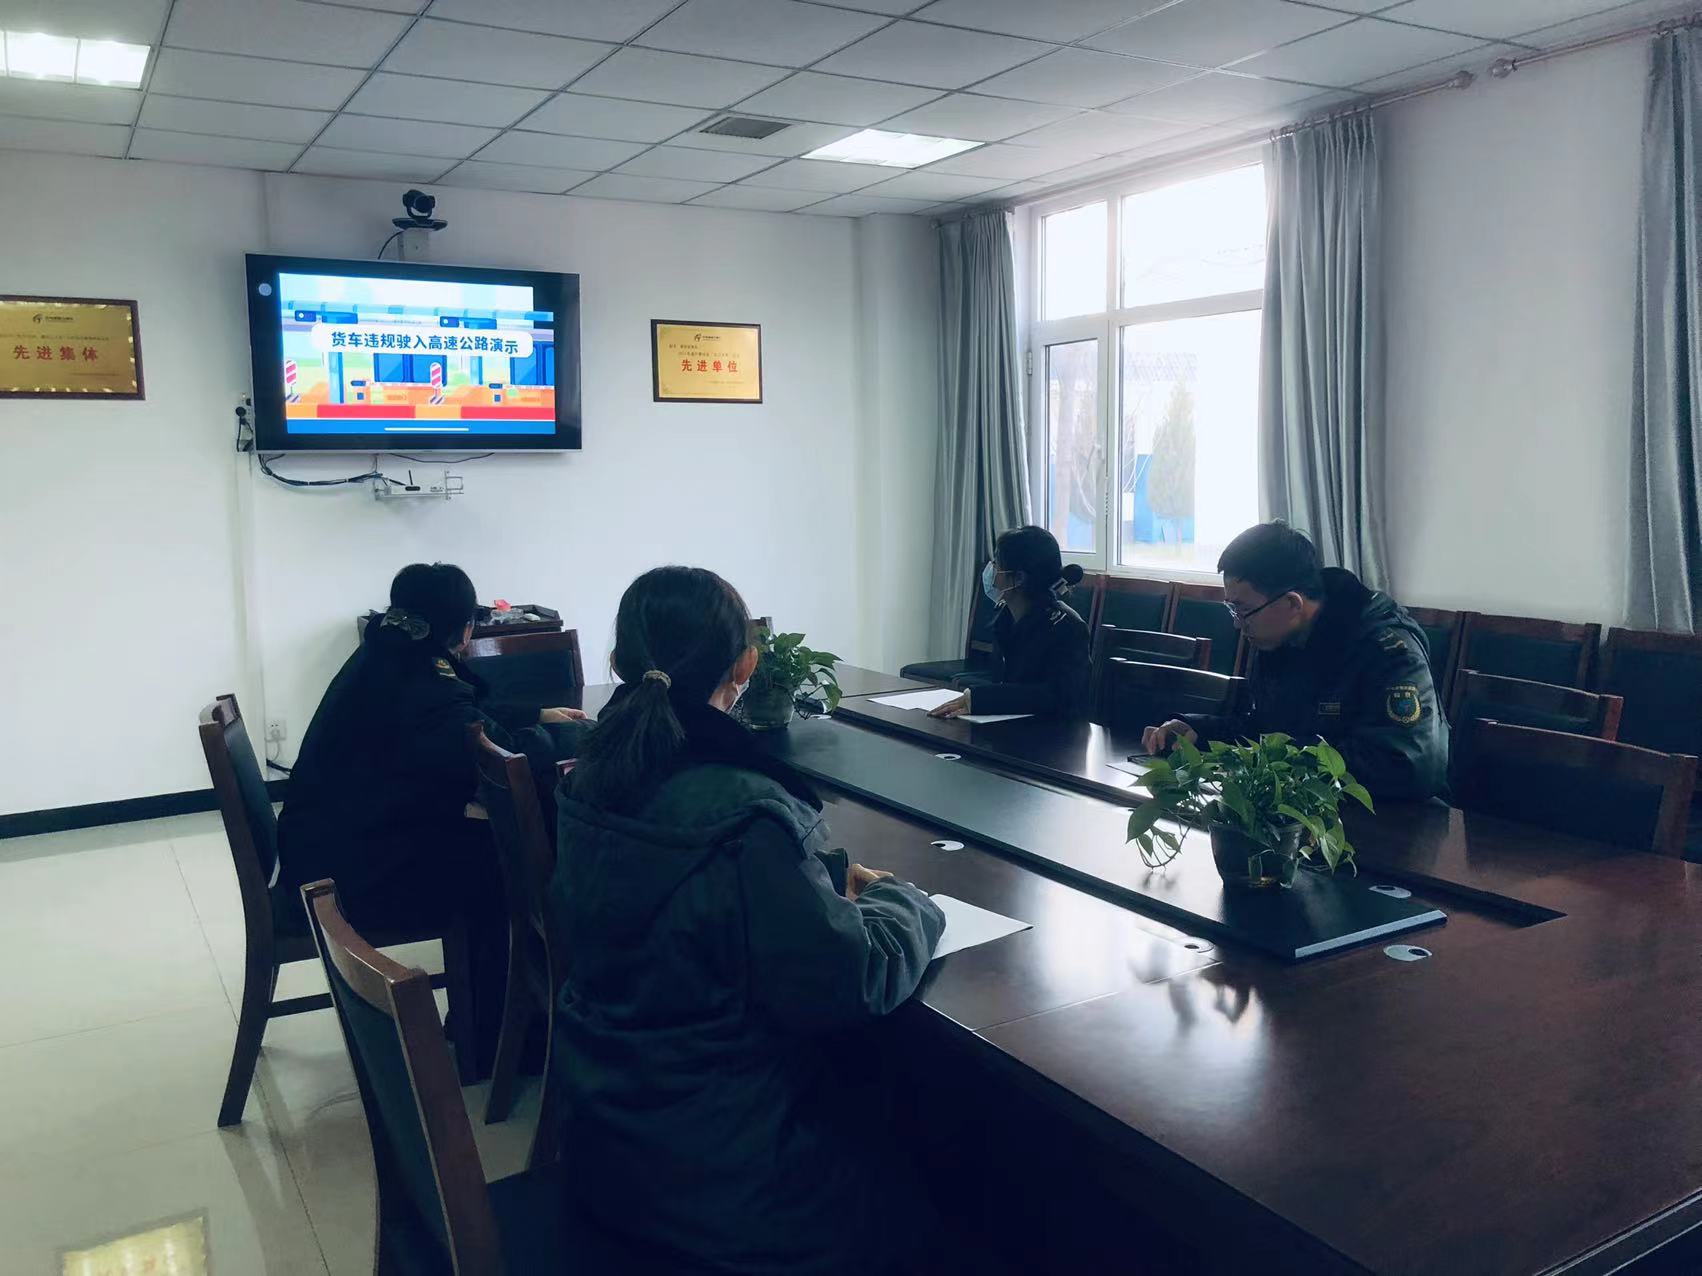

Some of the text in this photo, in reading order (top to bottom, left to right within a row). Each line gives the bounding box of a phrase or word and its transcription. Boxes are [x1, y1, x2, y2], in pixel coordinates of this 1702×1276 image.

[331, 331, 519, 354] 货车违规驶入高速公路演示
[14, 345, 98, 361] 先进集体
[681, 359, 738, 373] 先进单位
